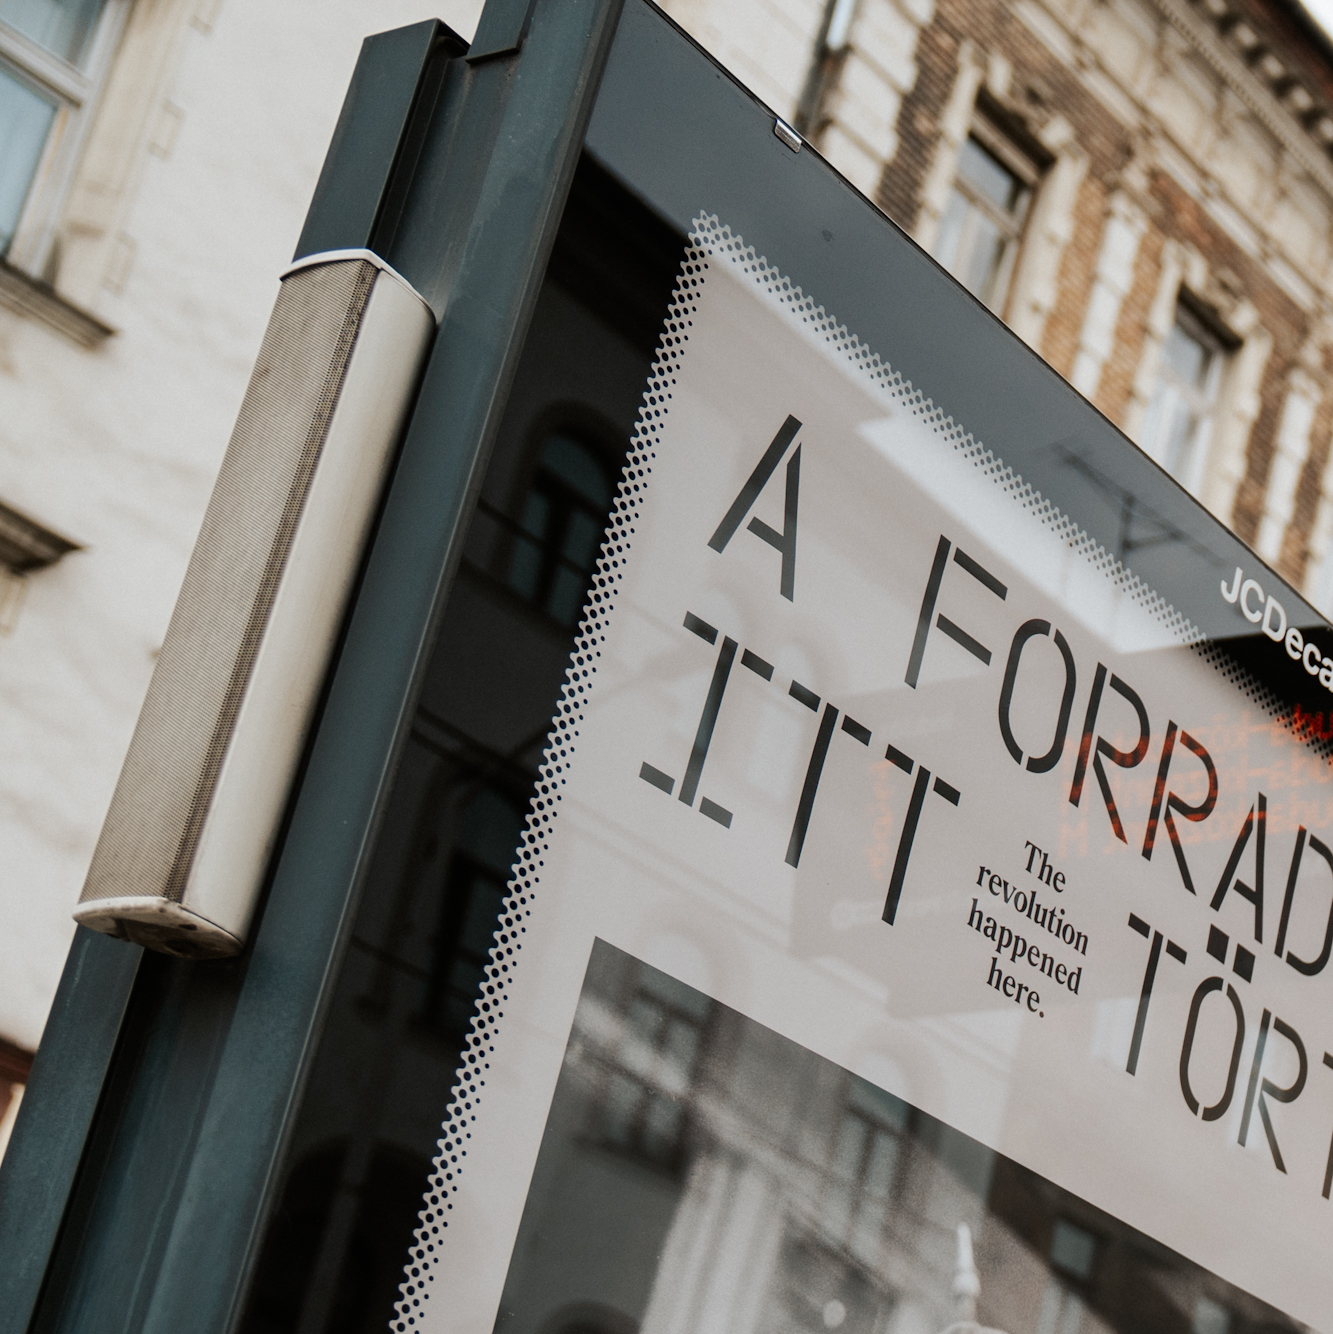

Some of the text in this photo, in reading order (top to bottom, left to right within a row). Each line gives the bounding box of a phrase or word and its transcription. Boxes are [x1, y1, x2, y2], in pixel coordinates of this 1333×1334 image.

[707, 414, 803, 603] A
[638, 611, 961, 926] ITT
[975, 865, 1089, 957] revolution
[1024, 839, 1067, 893] The
[966, 897, 1083, 995] happened
[986, 956, 1045, 1018] here.
